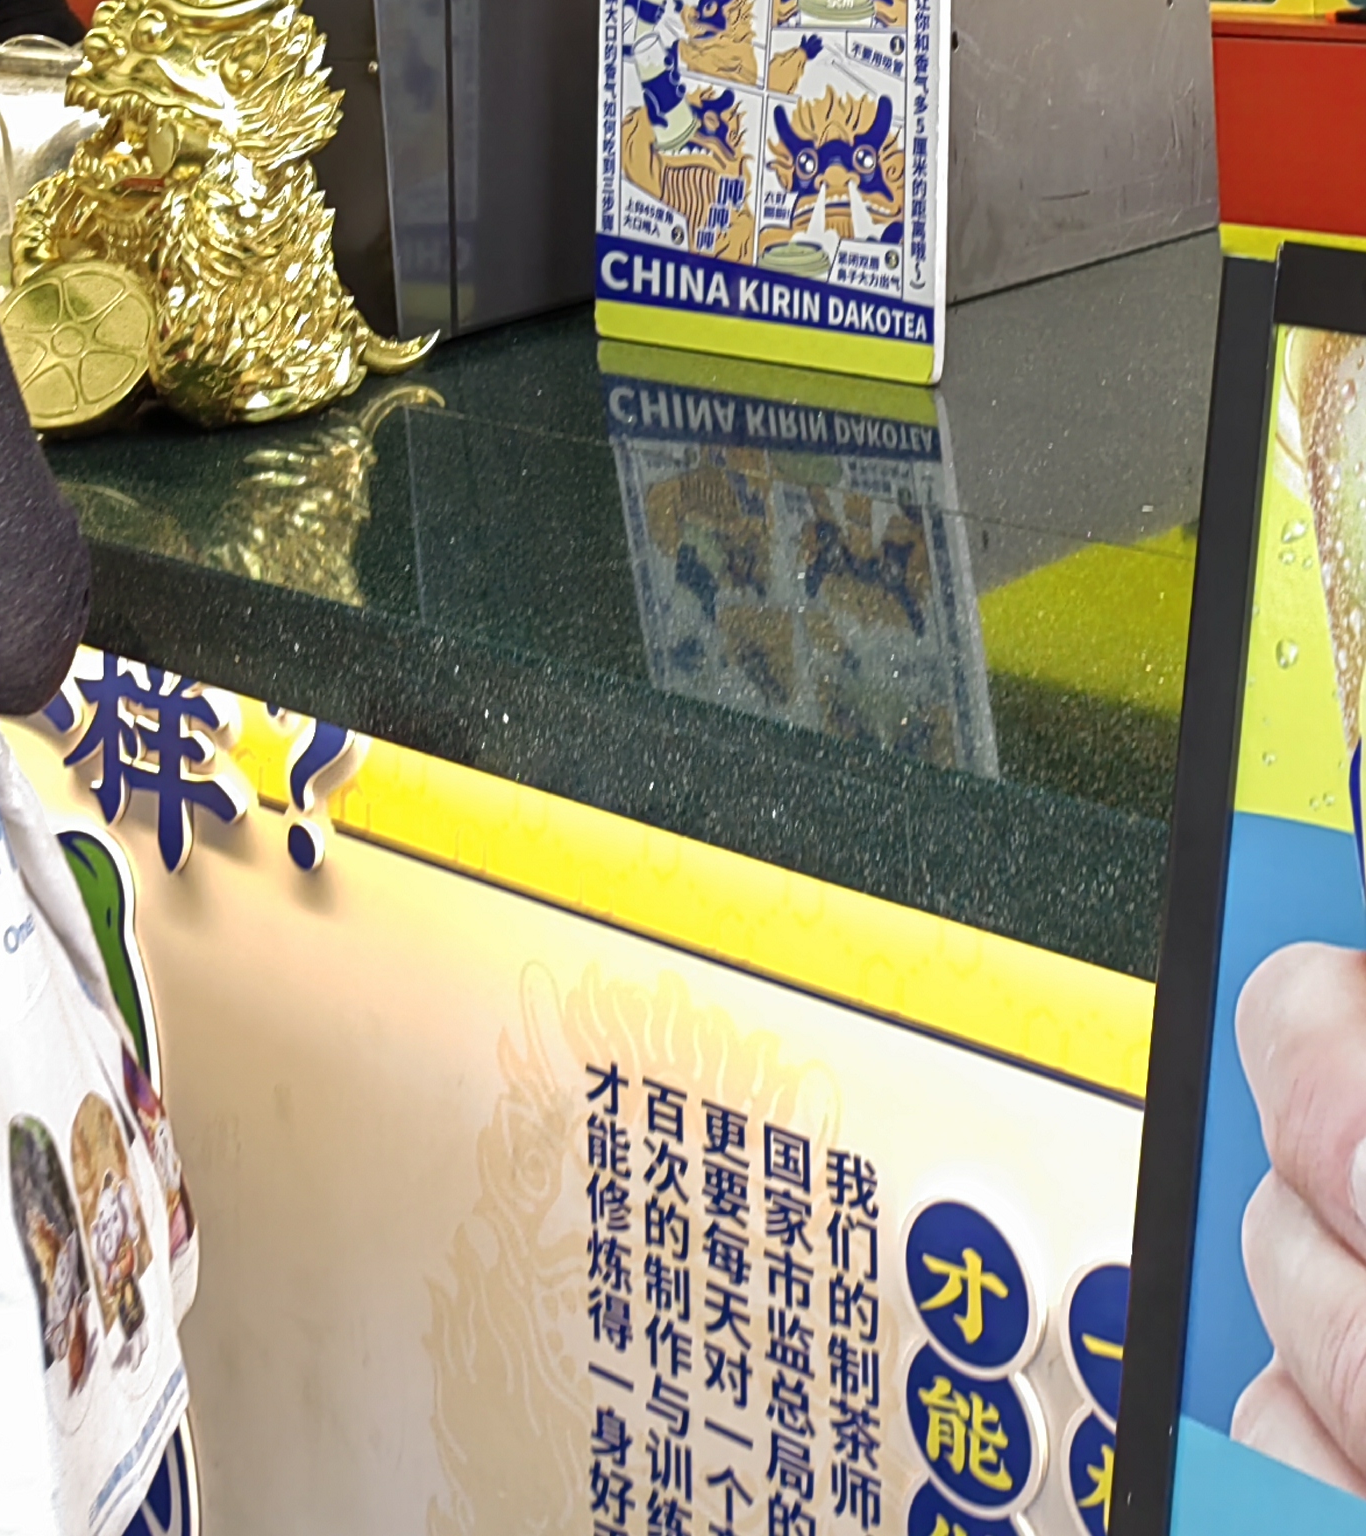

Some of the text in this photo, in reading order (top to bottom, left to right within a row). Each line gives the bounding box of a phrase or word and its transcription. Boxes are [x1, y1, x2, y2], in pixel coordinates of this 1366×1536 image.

[600, 249, 927, 340] CHINA KIRIN DAKOTEA
[702, 1099, 753, 1536] 更要每天对一个
[826, 1148, 882, 1531] 我们的制茶师
[919, 1247, 1012, 1536] 才能
